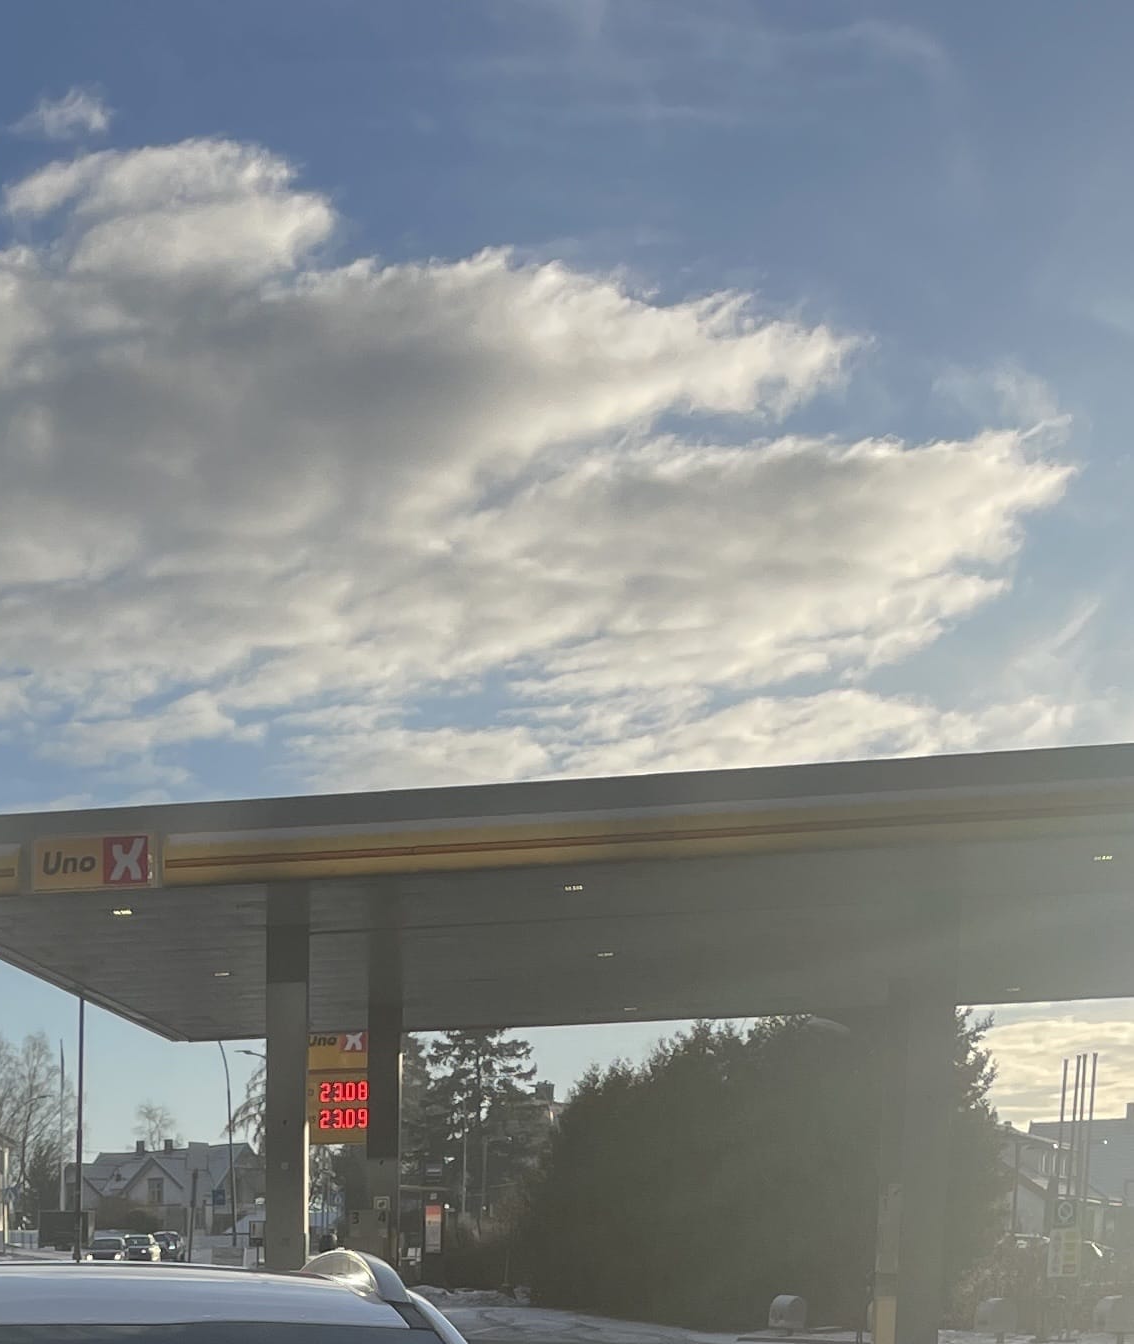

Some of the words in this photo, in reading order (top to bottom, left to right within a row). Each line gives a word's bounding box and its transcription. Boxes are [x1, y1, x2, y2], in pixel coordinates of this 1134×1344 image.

[43, 851, 96, 875] Uno
[110, 837, 146, 881] X
[344, 1032, 363, 1050] X
[319, 1081, 368, 1103] 23.08
[319, 1108, 368, 1129] 23.09
[352, 1211, 360, 1225] 3
[377, 1210, 387, 1223] 4
